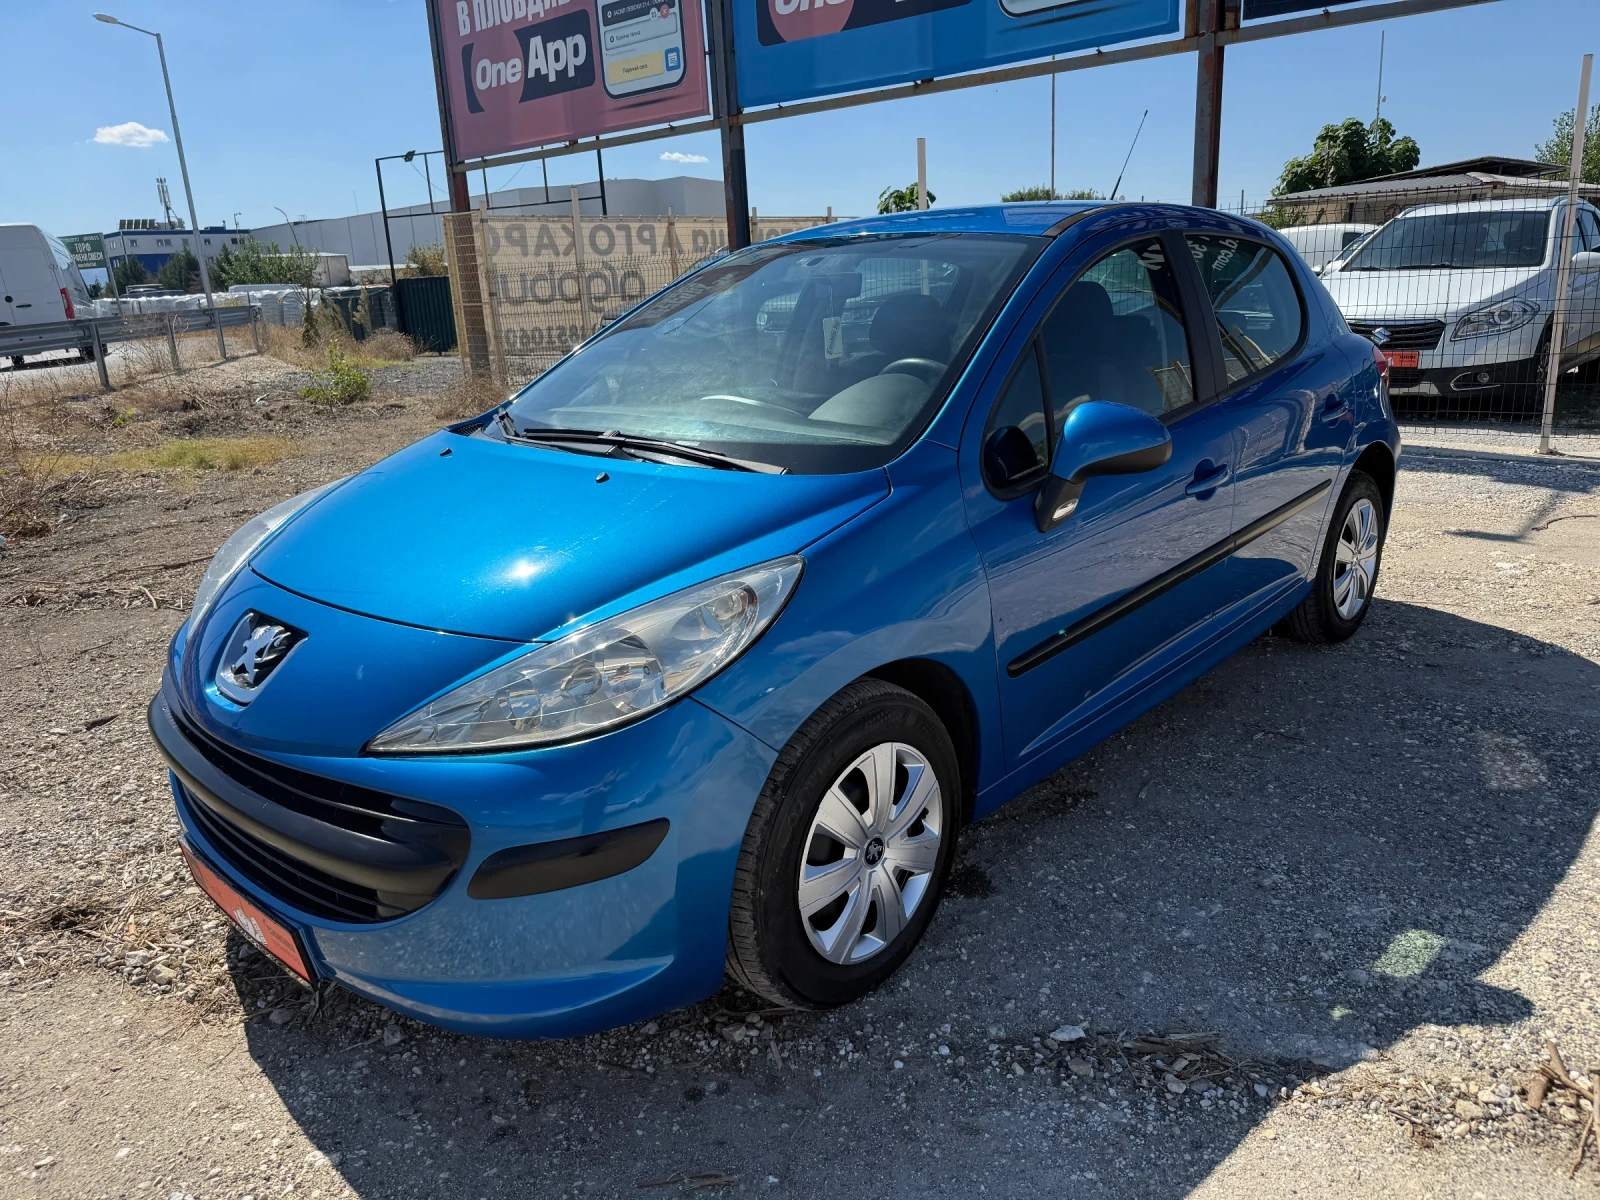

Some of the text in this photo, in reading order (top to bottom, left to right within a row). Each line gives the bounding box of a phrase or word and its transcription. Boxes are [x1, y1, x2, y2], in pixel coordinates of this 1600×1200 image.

[456, 0, 570, 37] В ПЛОВД
[475, 33, 587, 91] One App
